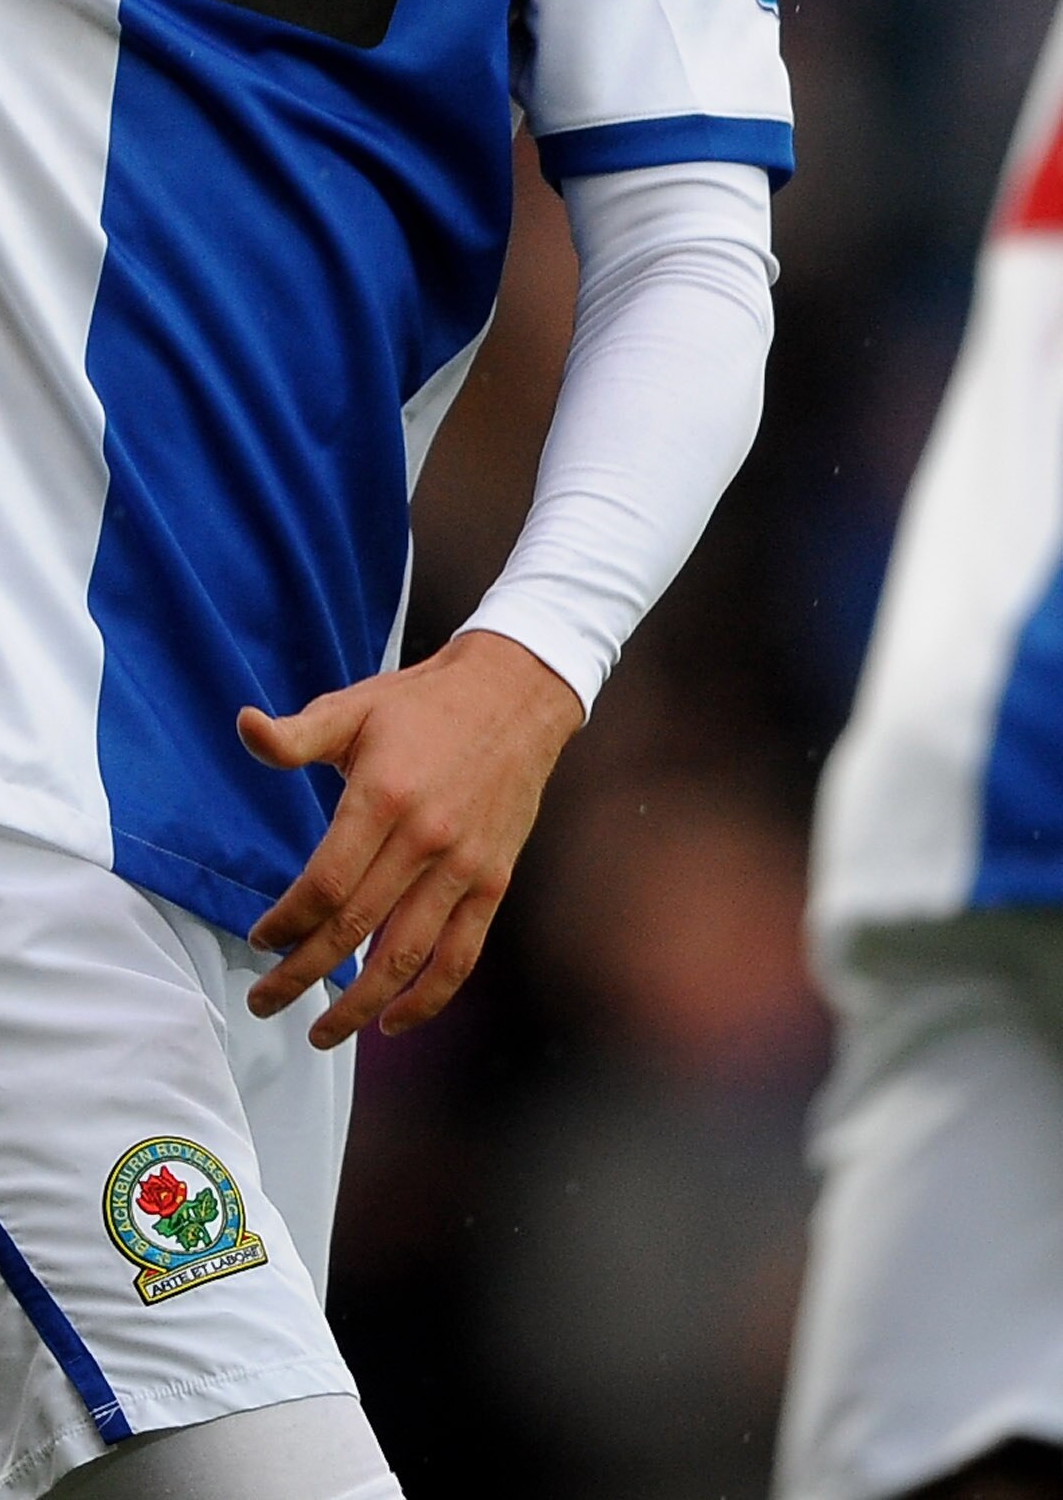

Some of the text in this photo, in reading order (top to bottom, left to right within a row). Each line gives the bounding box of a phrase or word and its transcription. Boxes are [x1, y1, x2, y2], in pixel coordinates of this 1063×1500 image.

[113, 1148, 153, 1255] BLACKBURN
[157, 1144, 226, 1182] ROVERS
[152, 1247, 259, 1297] ARTE ET LABORE
